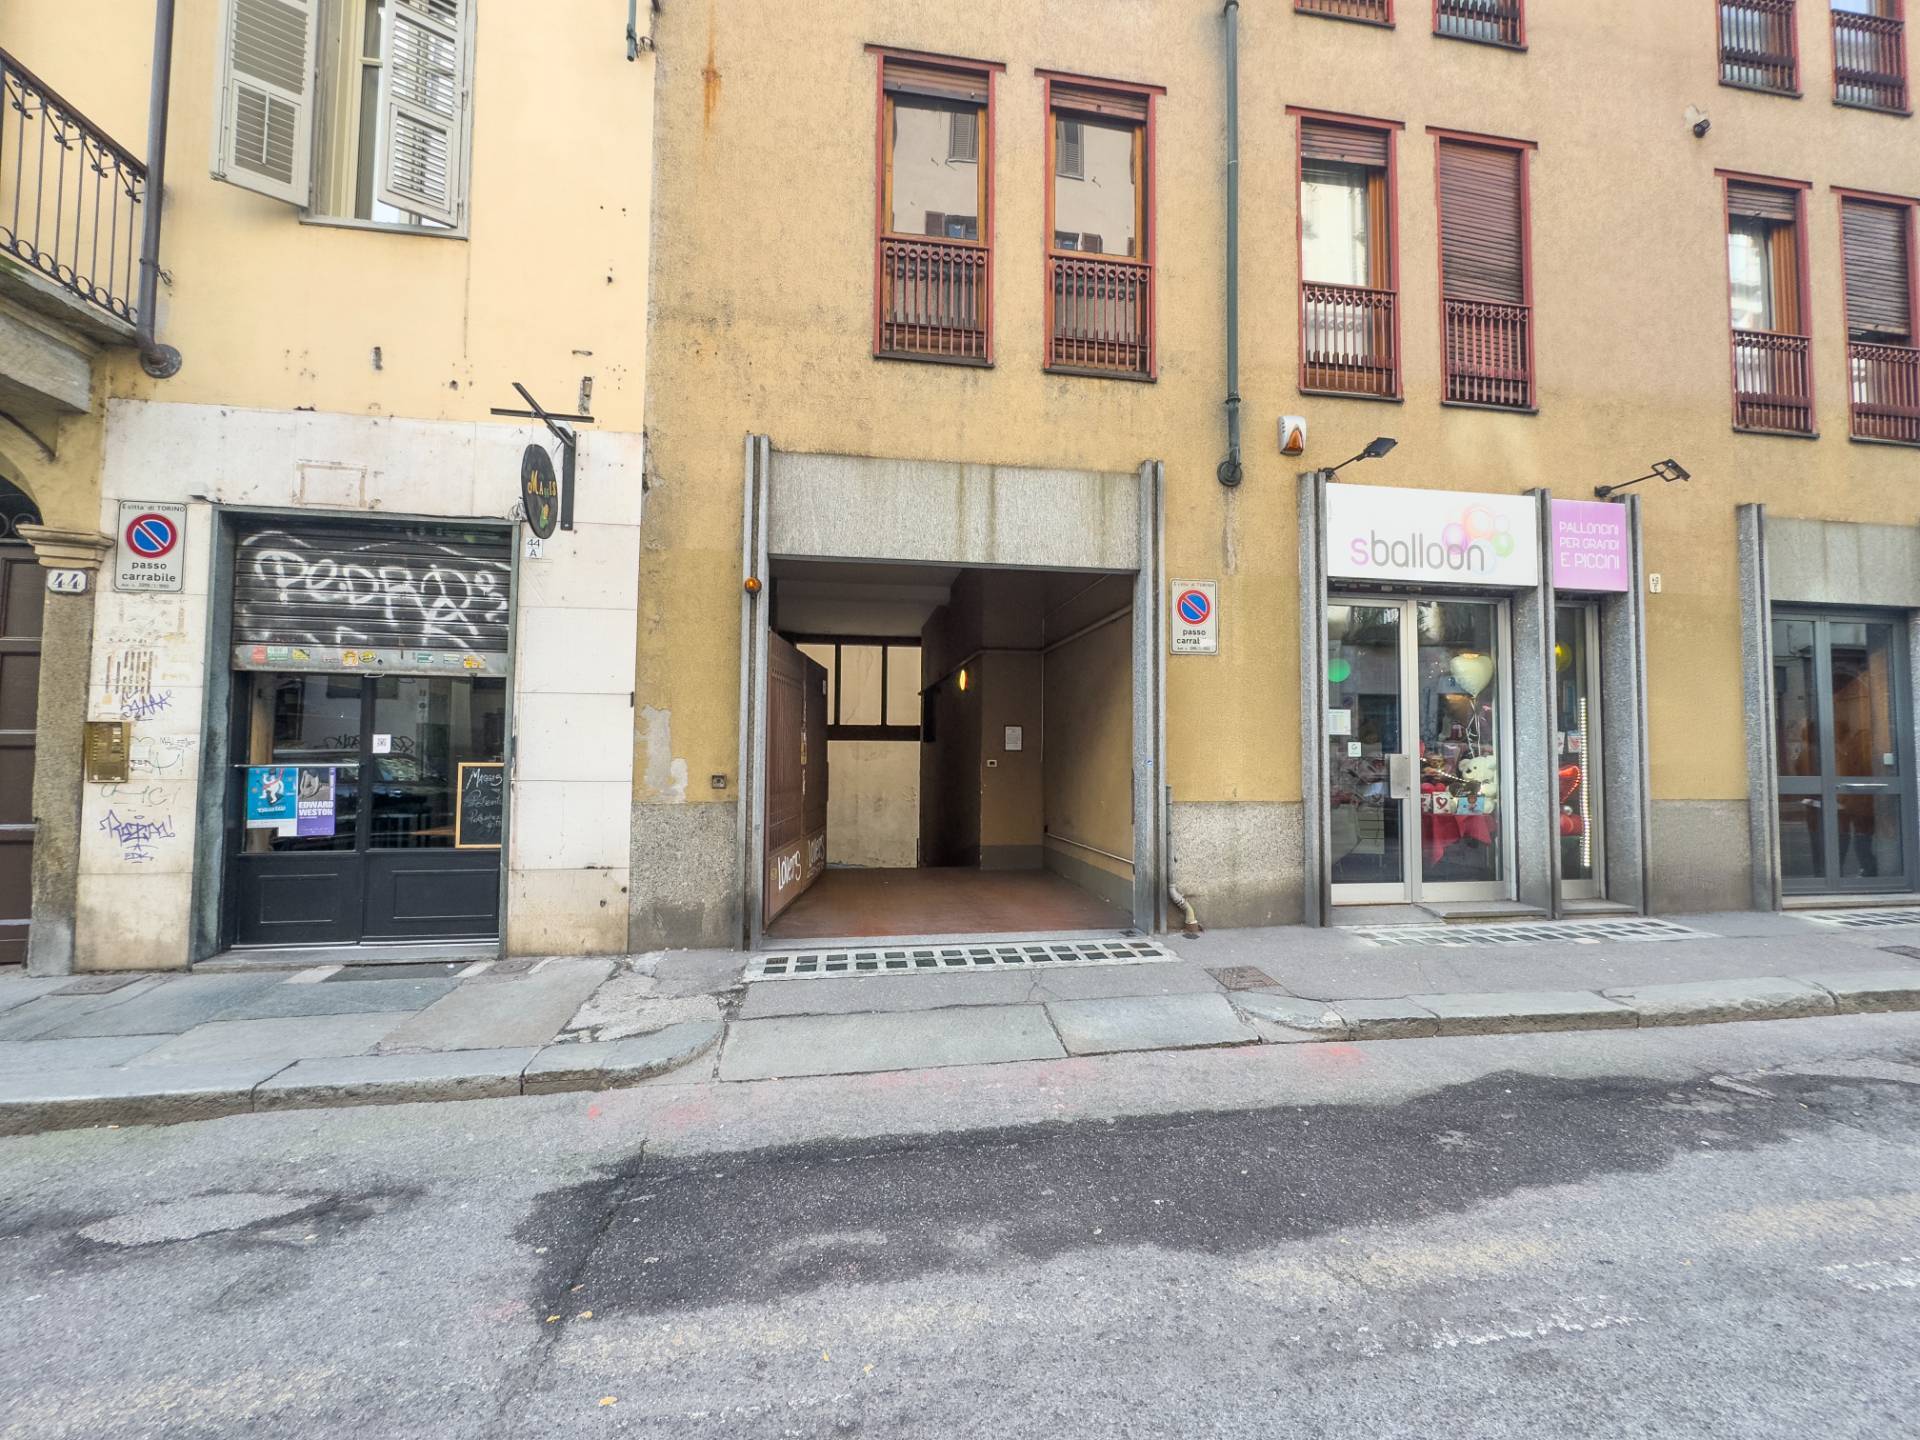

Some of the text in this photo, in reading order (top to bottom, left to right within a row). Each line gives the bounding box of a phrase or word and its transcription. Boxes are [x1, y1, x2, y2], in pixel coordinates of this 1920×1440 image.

[157, 505, 186, 513] TORINO
[527, 538, 540, 546] 44
[1560, 537, 1619, 550] PER GRANDI
[529, 547, 537, 557] A
[1351, 530, 1484, 572] sballoon
[1561, 552, 1620, 569] E PICCINI
[131, 562, 168, 570] passo
[52, 572, 81, 590] 44
[121, 572, 177, 582] carrabile
[298, 801, 334, 809] EDWARD
